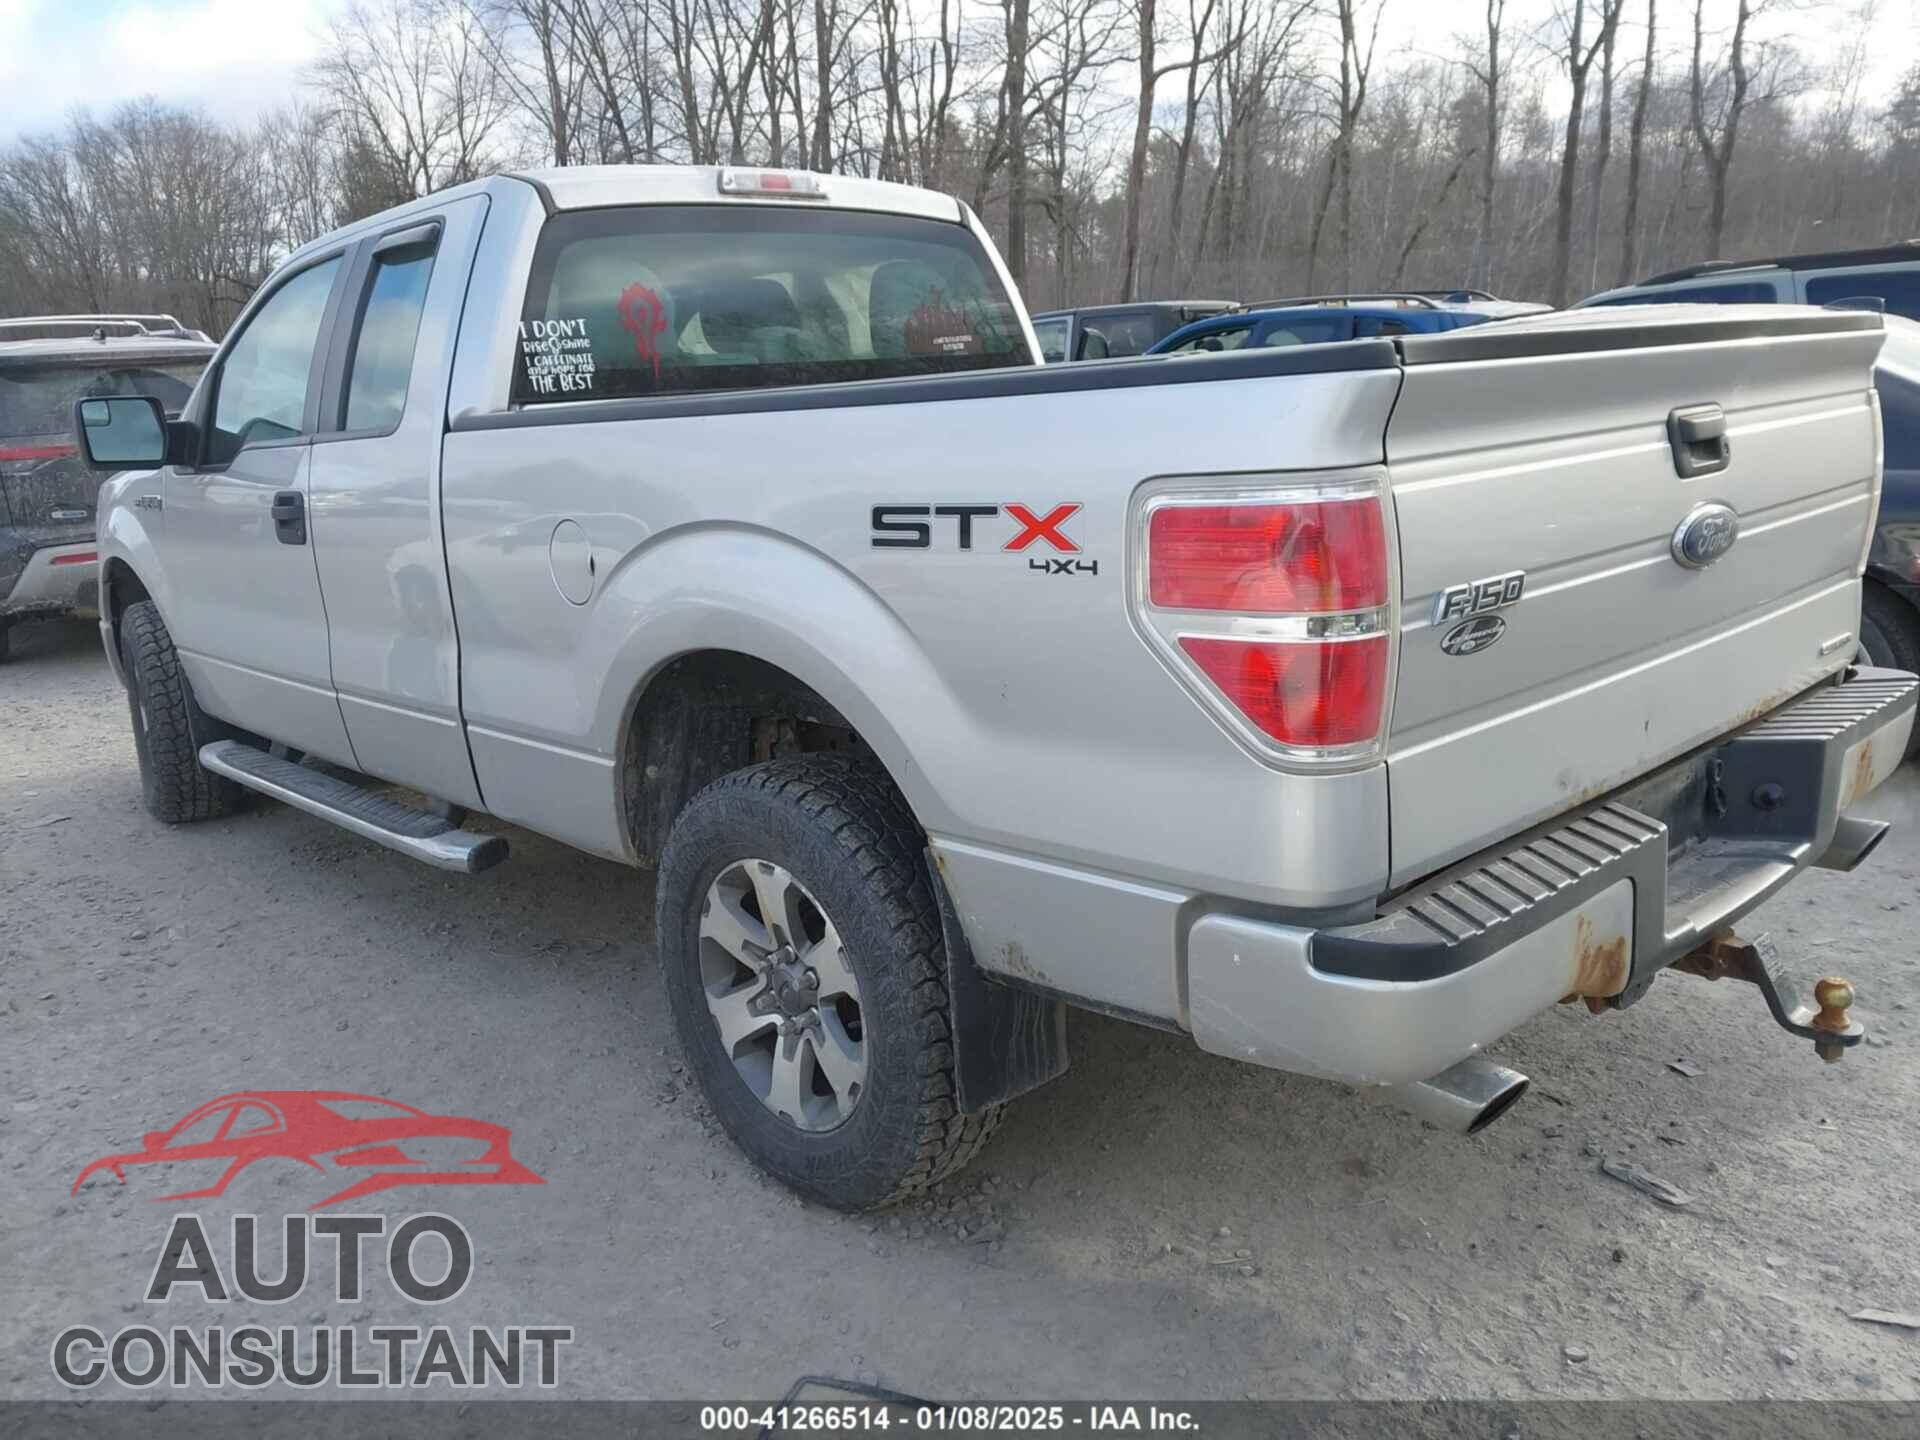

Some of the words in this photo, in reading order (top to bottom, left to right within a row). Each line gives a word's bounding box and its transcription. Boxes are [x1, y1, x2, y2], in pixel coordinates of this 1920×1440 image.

[517, 320, 528, 339] I
[532, 318, 586, 338] DON'T
[525, 356, 530, 367] I
[529, 374, 558, 394] THE
[560, 373, 593, 392] BEST
[871, 502, 1083, 552] STX
[1437, 570, 1526, 622] F-150
